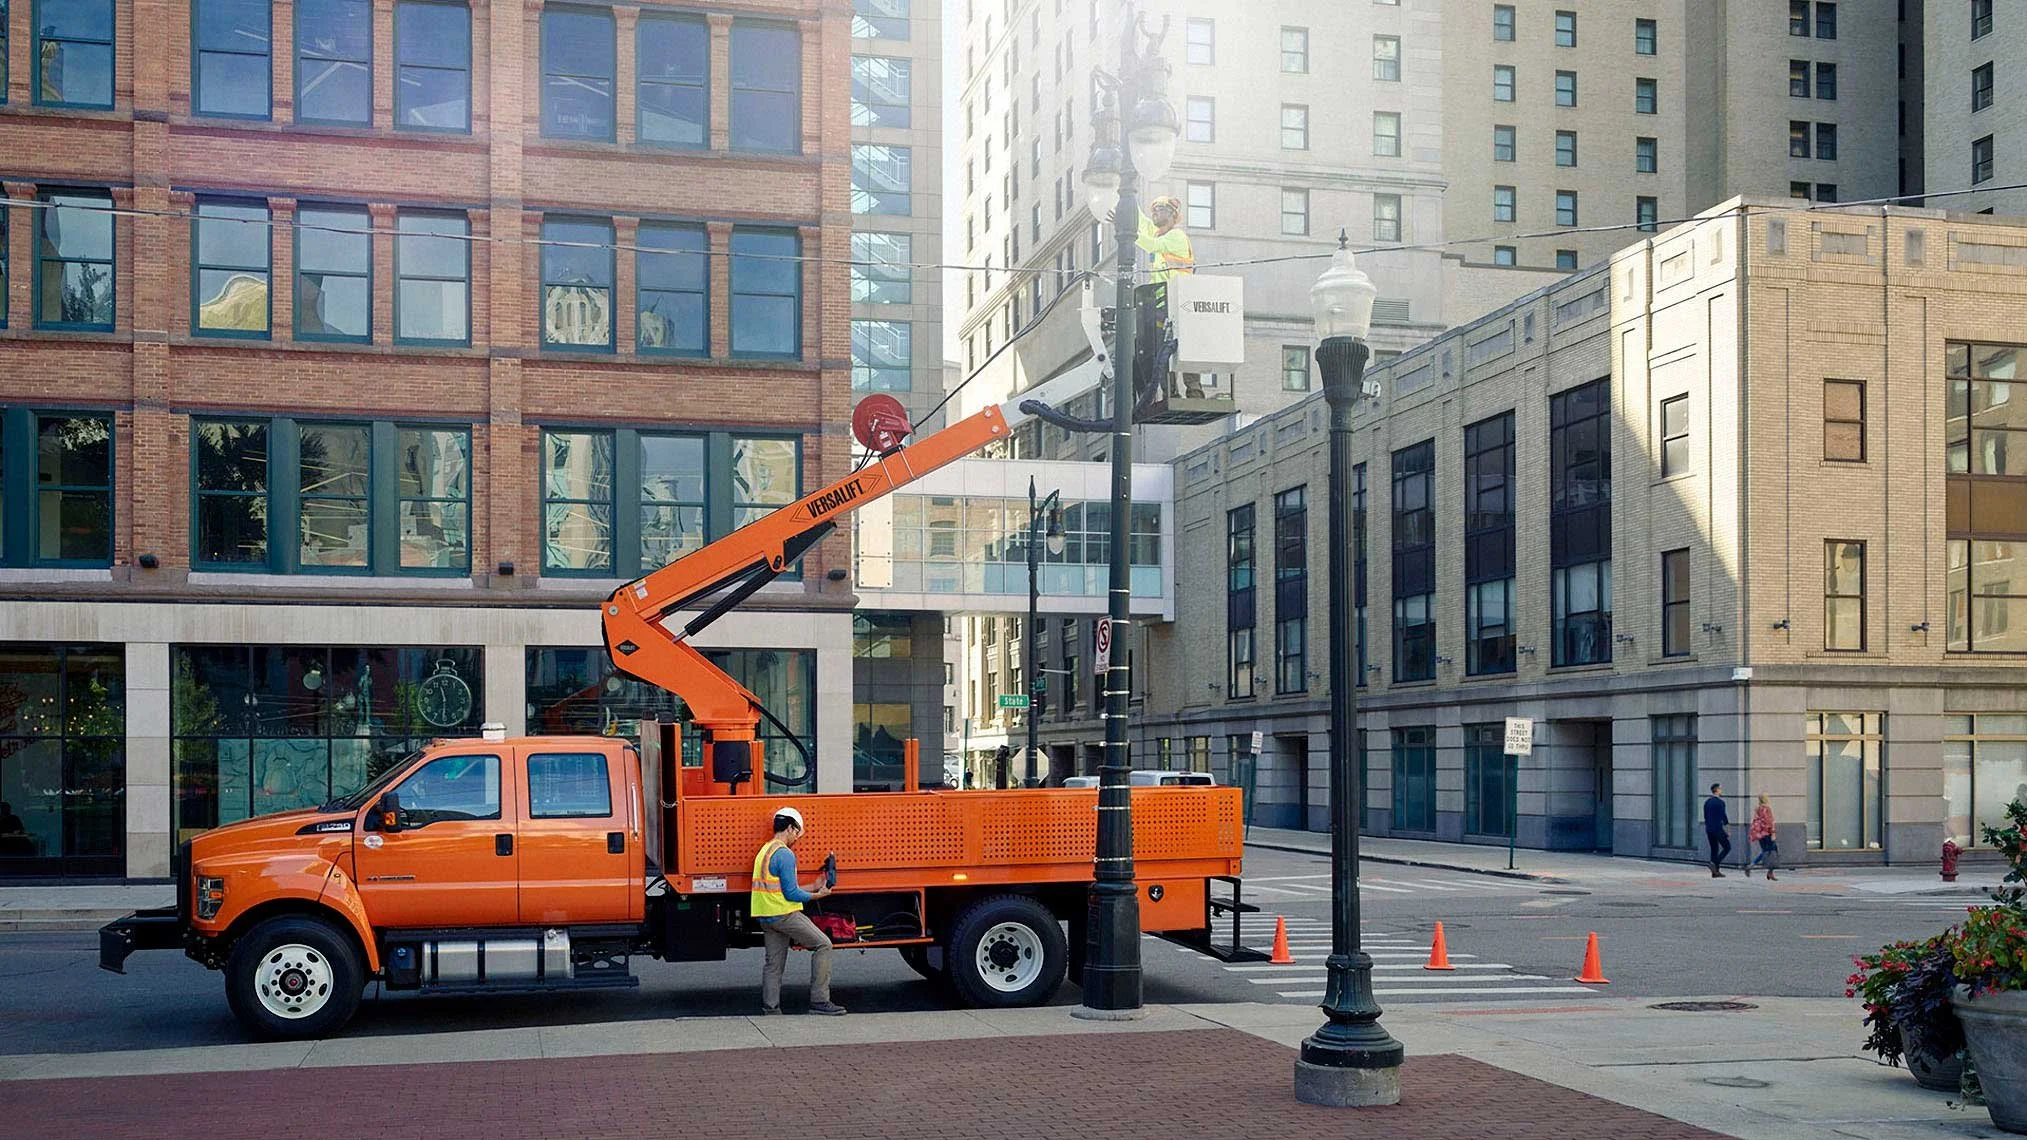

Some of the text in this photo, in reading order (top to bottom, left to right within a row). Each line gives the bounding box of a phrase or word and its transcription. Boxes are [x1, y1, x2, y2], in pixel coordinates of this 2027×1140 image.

[1193, 301, 1230, 313] VERSALIFT
[806, 478, 864, 518] VERSALIFT
[1004, 697, 1024, 706] State
